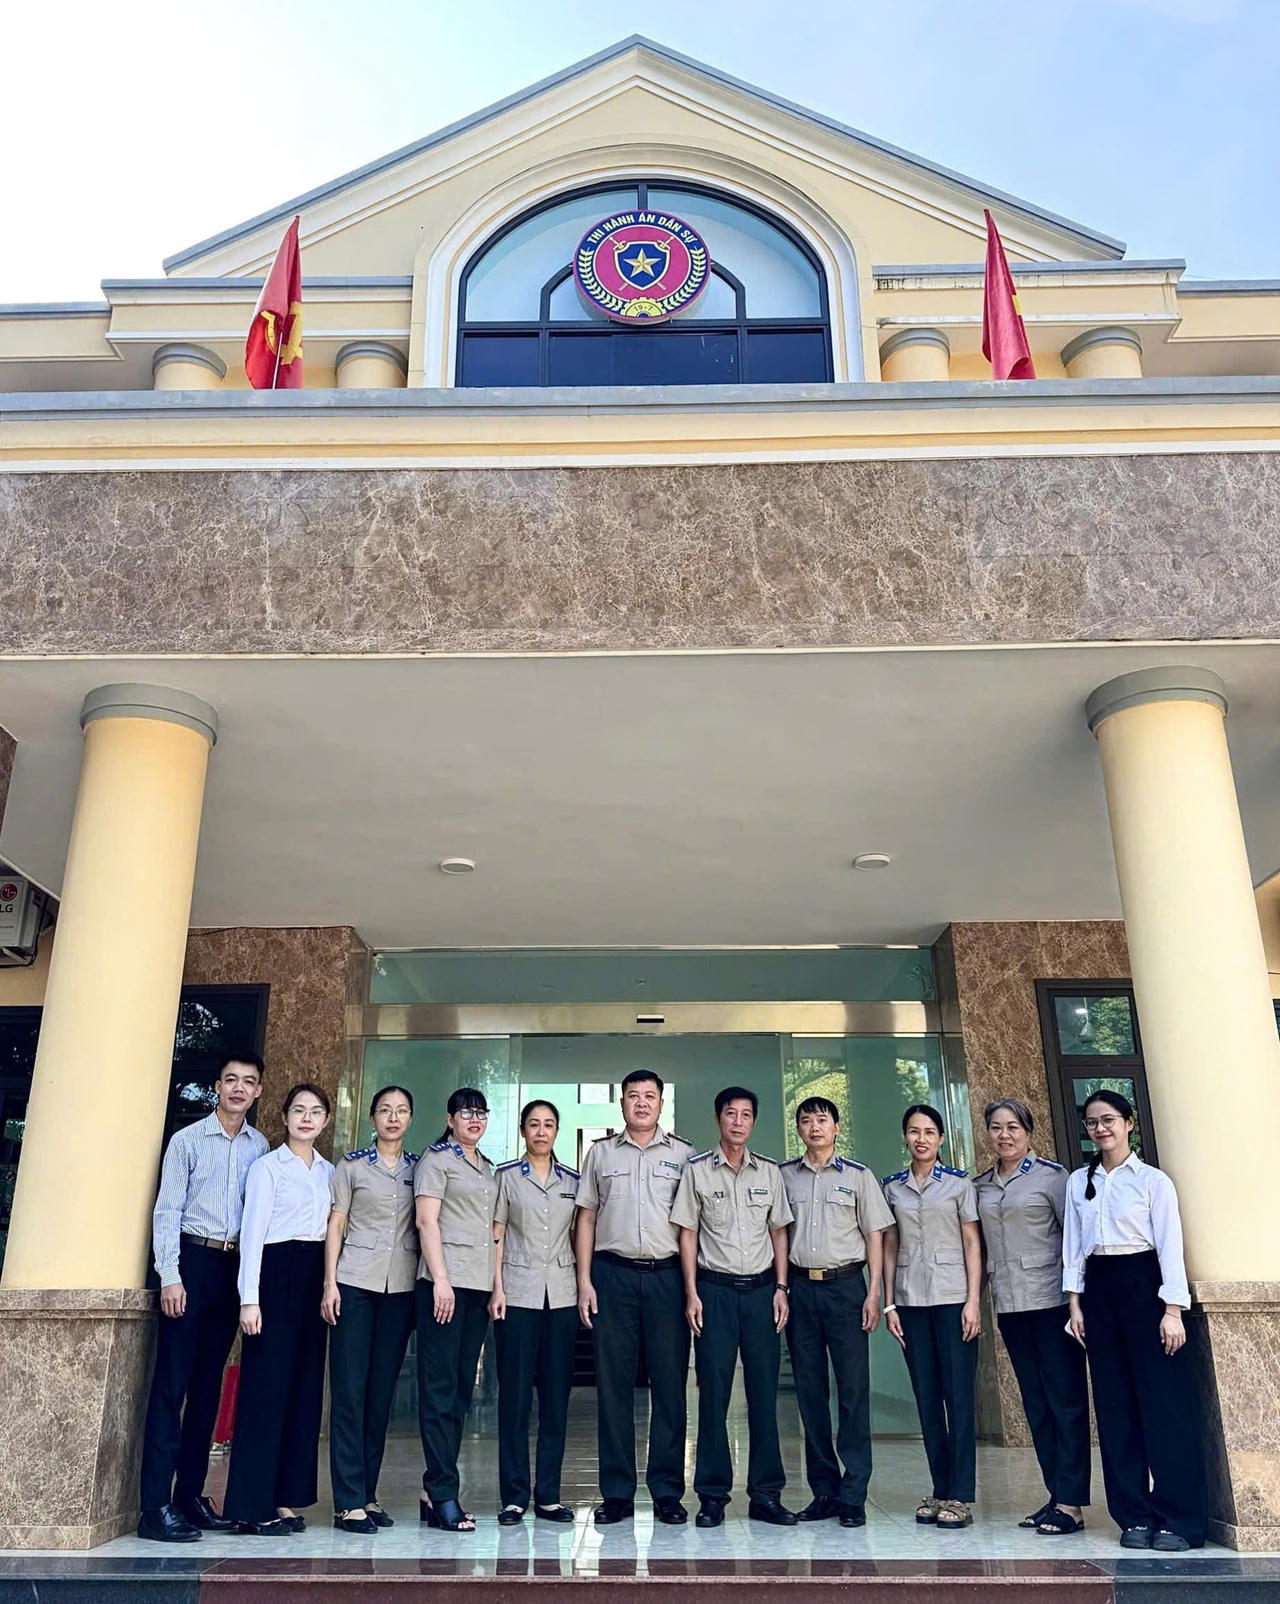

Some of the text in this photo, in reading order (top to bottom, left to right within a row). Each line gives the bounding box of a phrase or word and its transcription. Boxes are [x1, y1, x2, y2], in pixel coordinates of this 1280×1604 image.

[587, 212, 698, 243] THI HÀNH ÁN DÂN SỰ
[0, 904, 13, 913] LG
